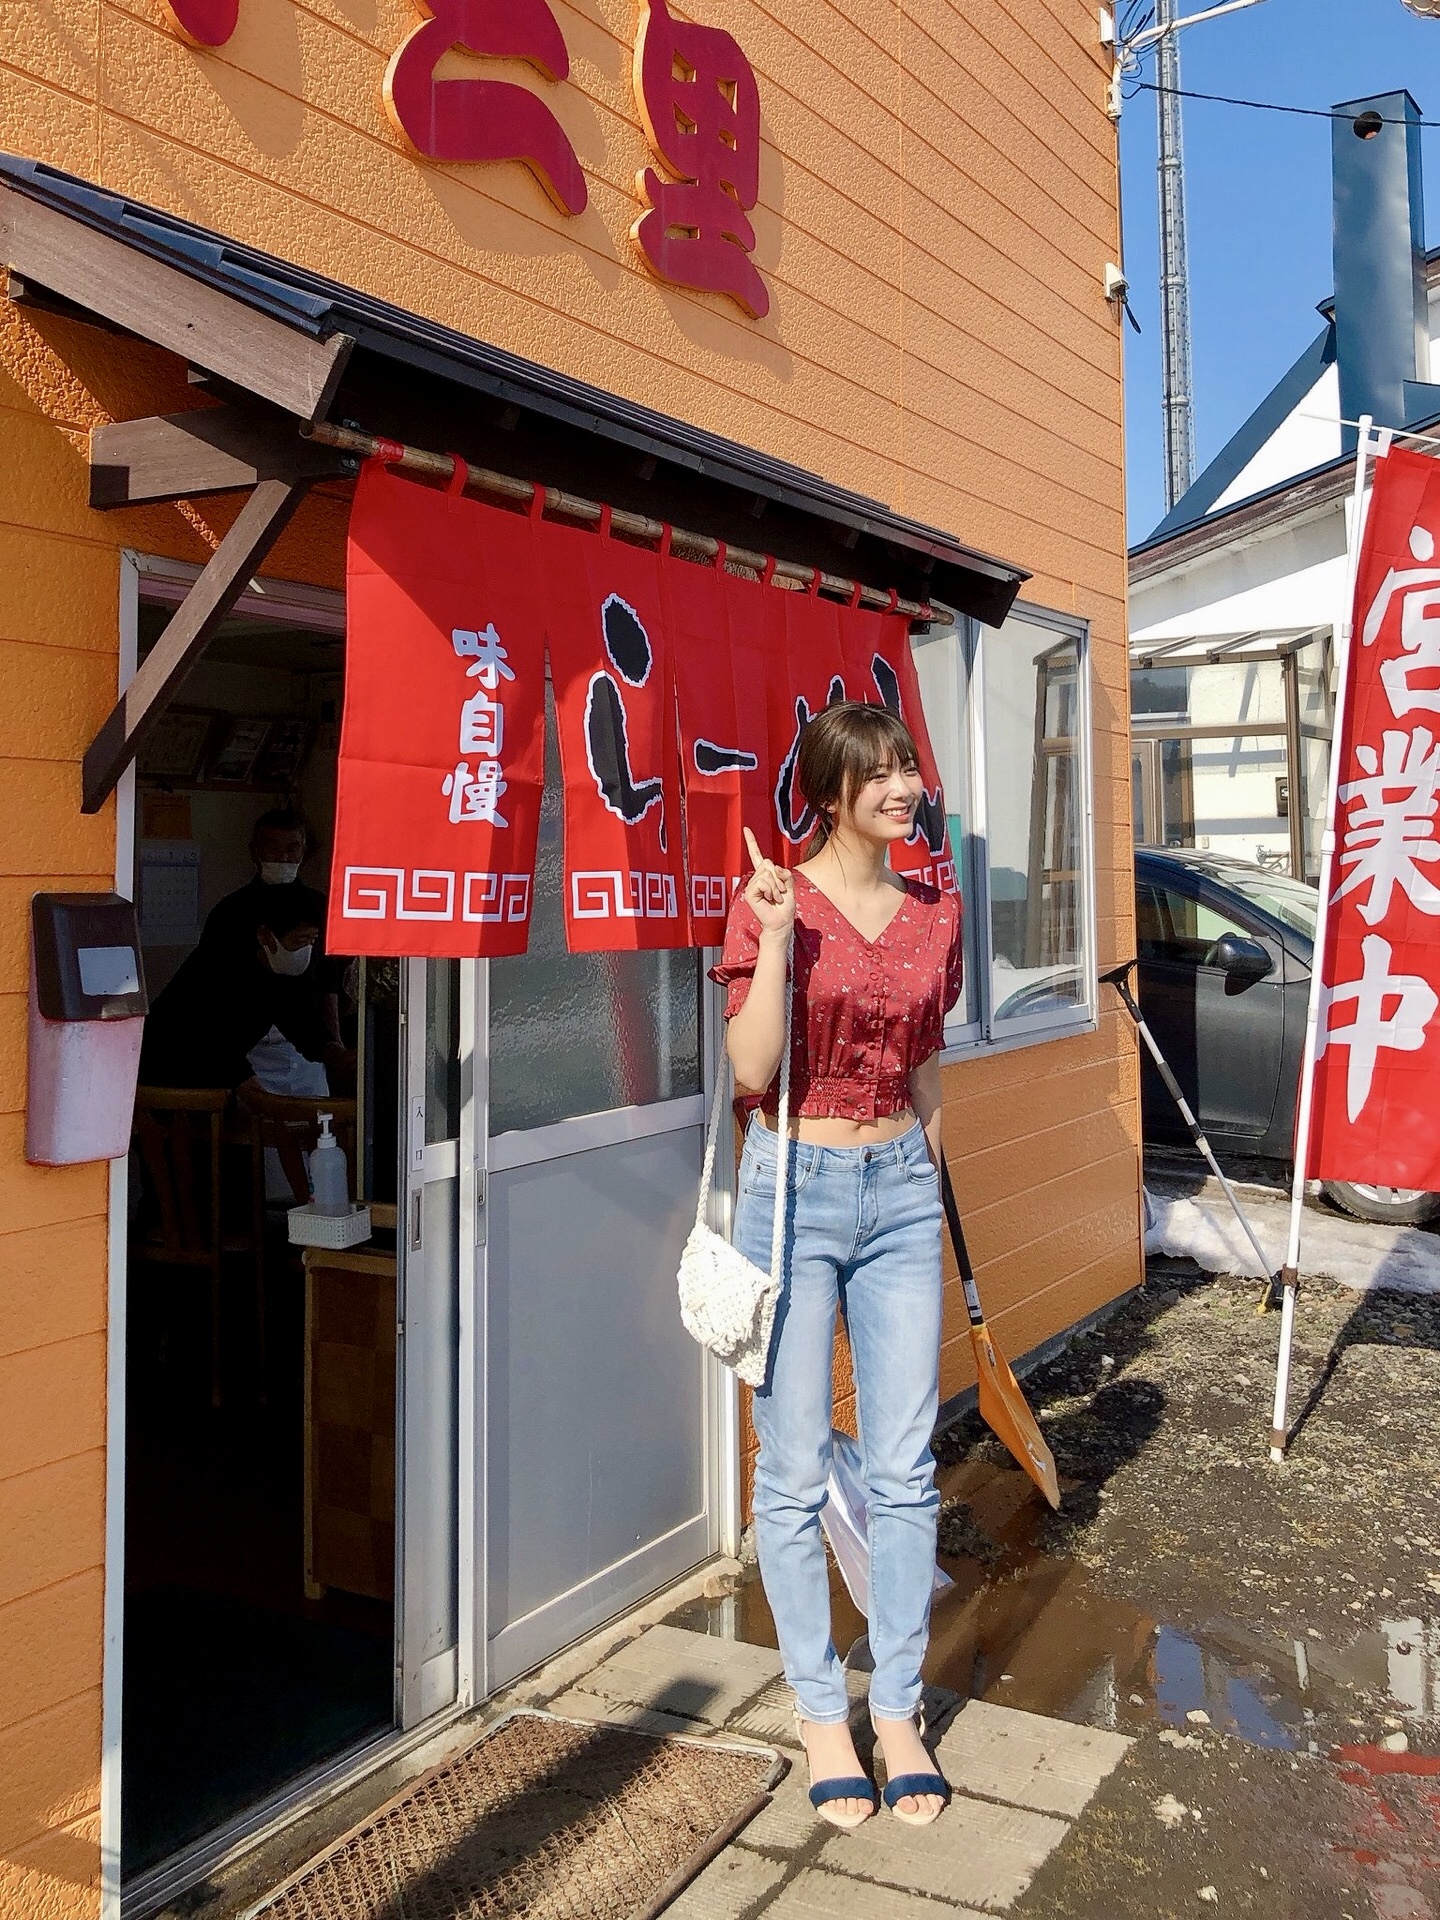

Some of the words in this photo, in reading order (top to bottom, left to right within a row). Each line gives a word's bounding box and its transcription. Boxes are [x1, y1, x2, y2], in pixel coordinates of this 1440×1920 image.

[441, 622, 517, 828] 味自慢
[415, 1105, 424, 1161] 入口
